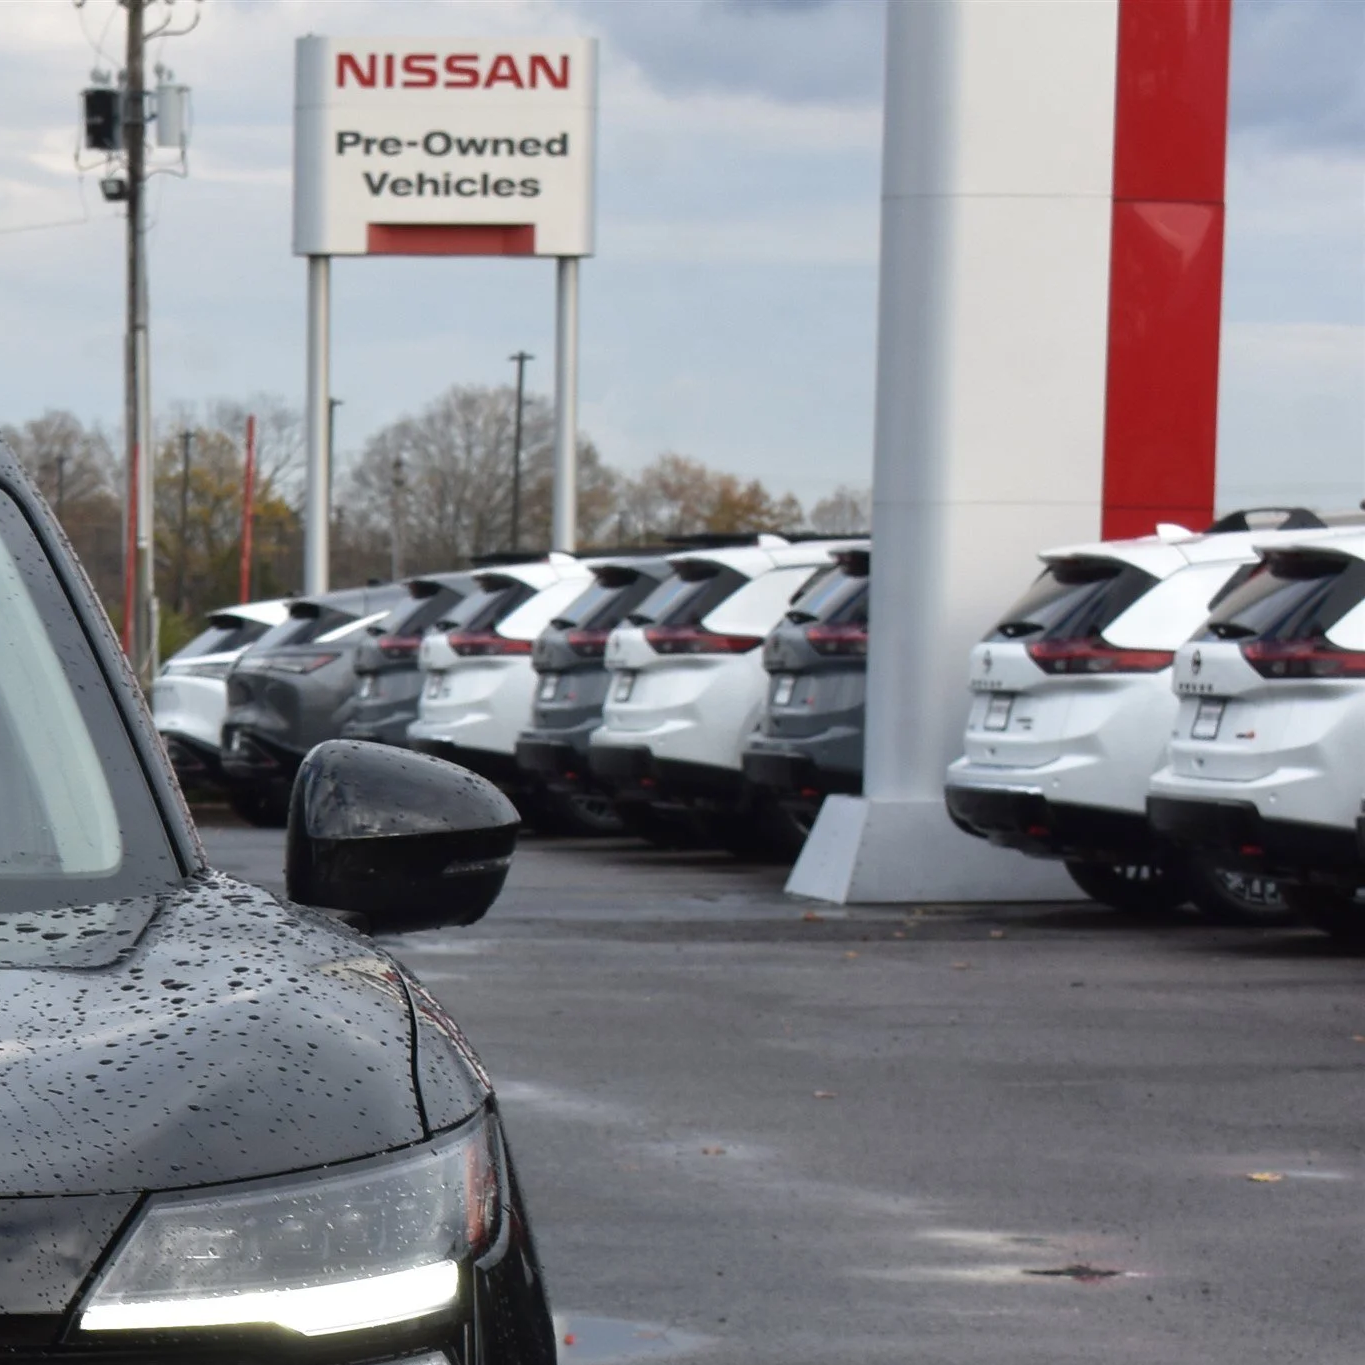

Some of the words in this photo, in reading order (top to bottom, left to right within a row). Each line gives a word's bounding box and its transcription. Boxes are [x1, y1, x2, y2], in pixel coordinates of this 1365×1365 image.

[335, 53, 570, 90] NISSAN
[335, 130, 569, 157] Pre-Owned
[362, 172, 542, 198] Vehicles
